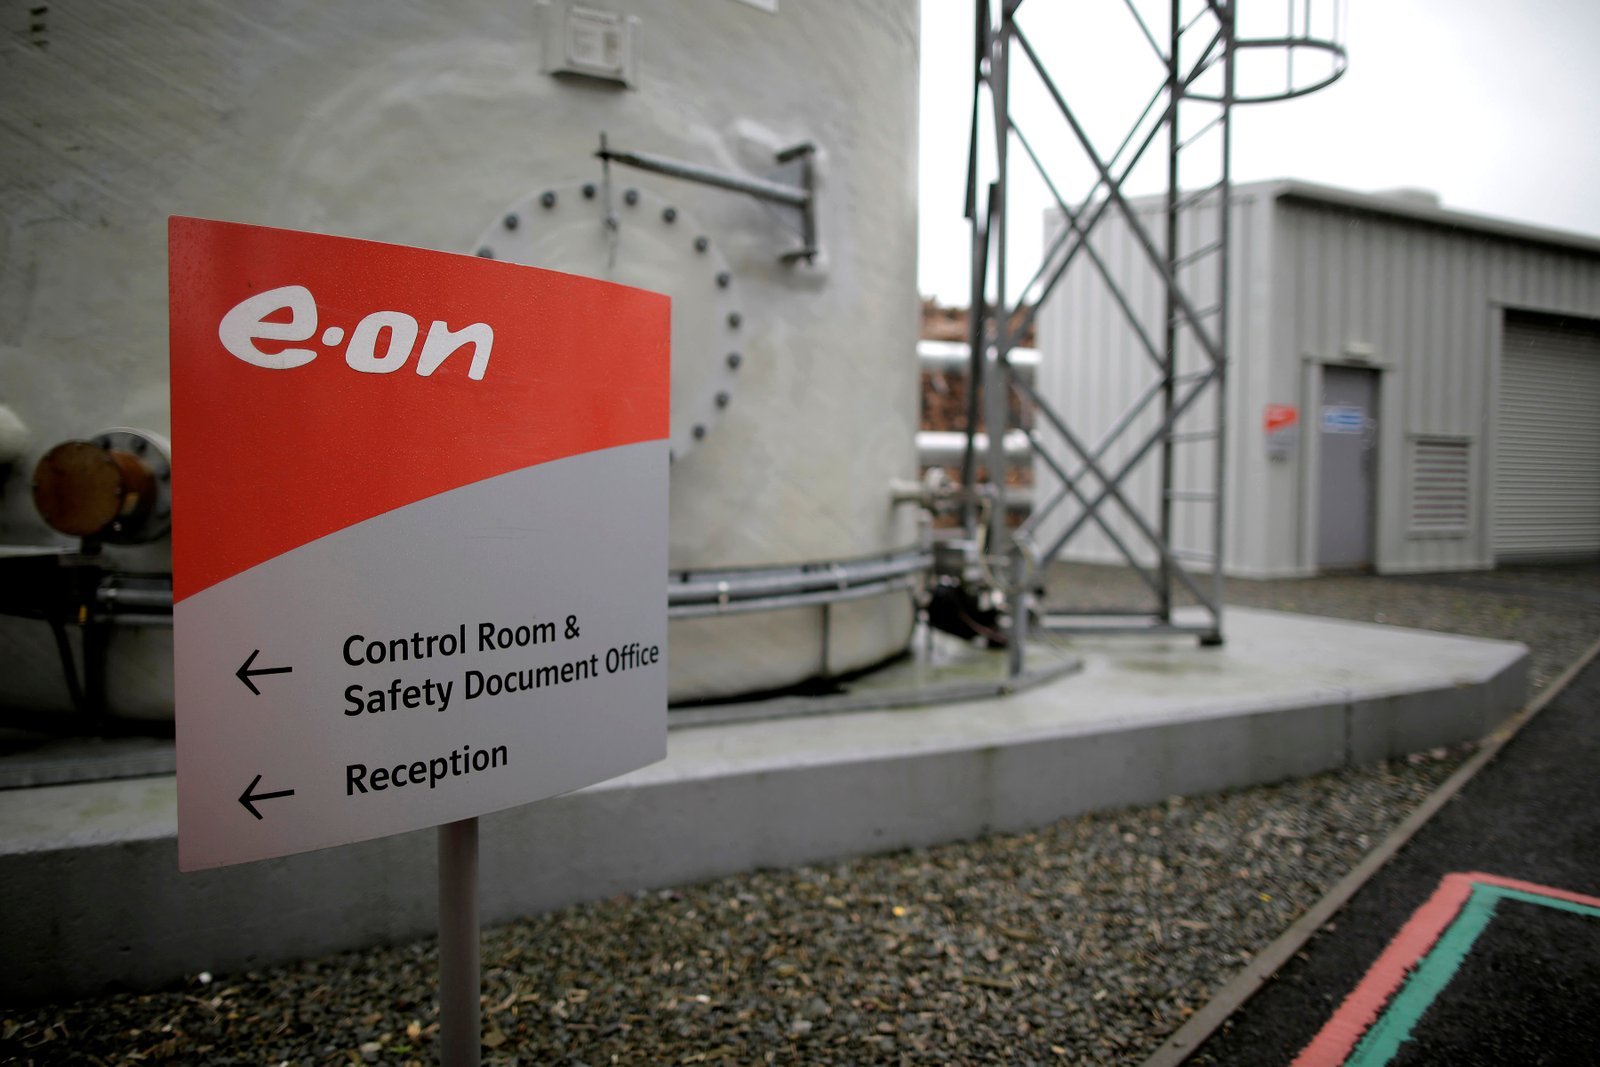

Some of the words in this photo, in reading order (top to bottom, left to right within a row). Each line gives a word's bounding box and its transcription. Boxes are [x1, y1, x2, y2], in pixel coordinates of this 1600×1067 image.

[342, 623, 467, 667] Control
[478, 621, 557, 653] Room
[564, 614, 580, 640] &
[343, 678, 455, 717] Safety
[465, 654, 600, 701] Document
[605, 642, 660, 675] Office
[346, 744, 509, 797] Reception
